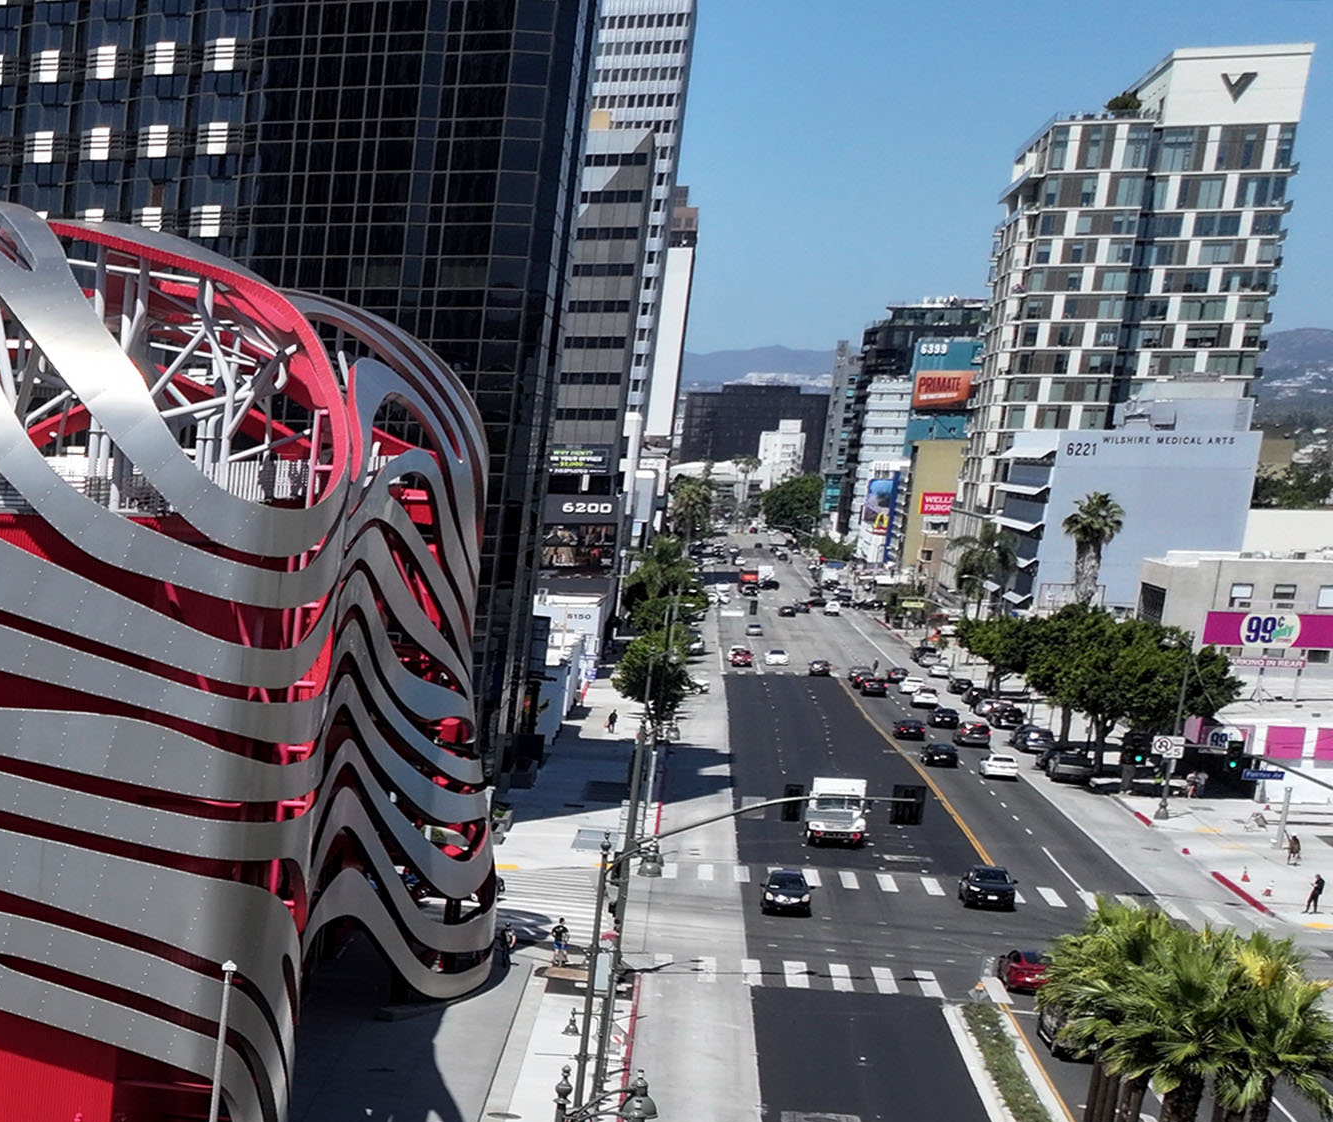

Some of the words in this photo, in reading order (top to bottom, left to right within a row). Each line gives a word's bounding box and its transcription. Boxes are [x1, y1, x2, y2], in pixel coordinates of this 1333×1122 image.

[920, 343, 948, 355] 6399
[918, 376, 961, 394] PRIMATE
[1102, 436, 1151, 445] WILSHIRE
[1157, 436, 1202, 445] MEDICAL
[1207, 436, 1235, 445] ARTS
[1066, 442, 1097, 456] 6221
[561, 502, 613, 514] 6200
